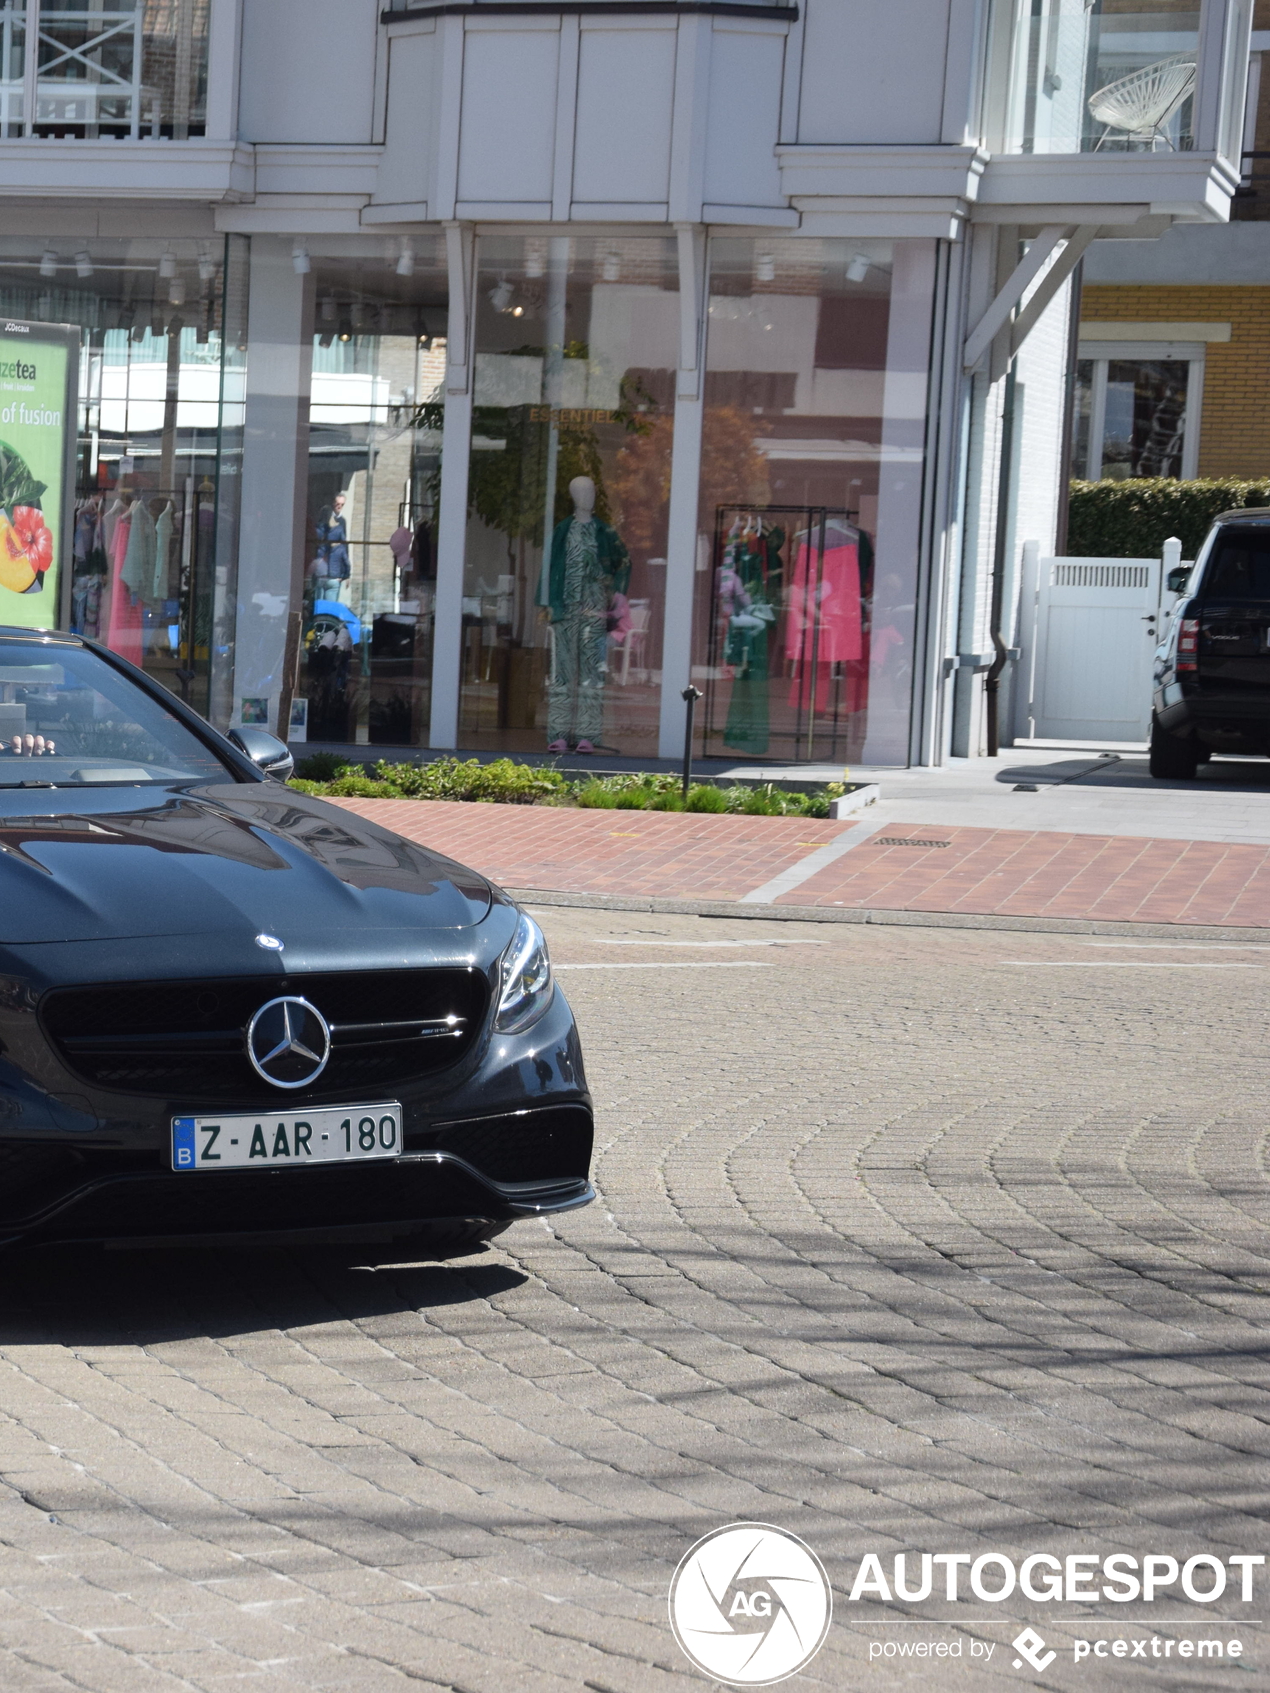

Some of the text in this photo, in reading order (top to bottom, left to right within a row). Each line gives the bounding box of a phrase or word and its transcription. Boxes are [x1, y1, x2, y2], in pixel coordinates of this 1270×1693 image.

[4, 322, 30, 333] JCDecaux
[1, 401, 17, 424] of
[19, 402, 61, 426] fusion
[177, 1147, 192, 1165] B
